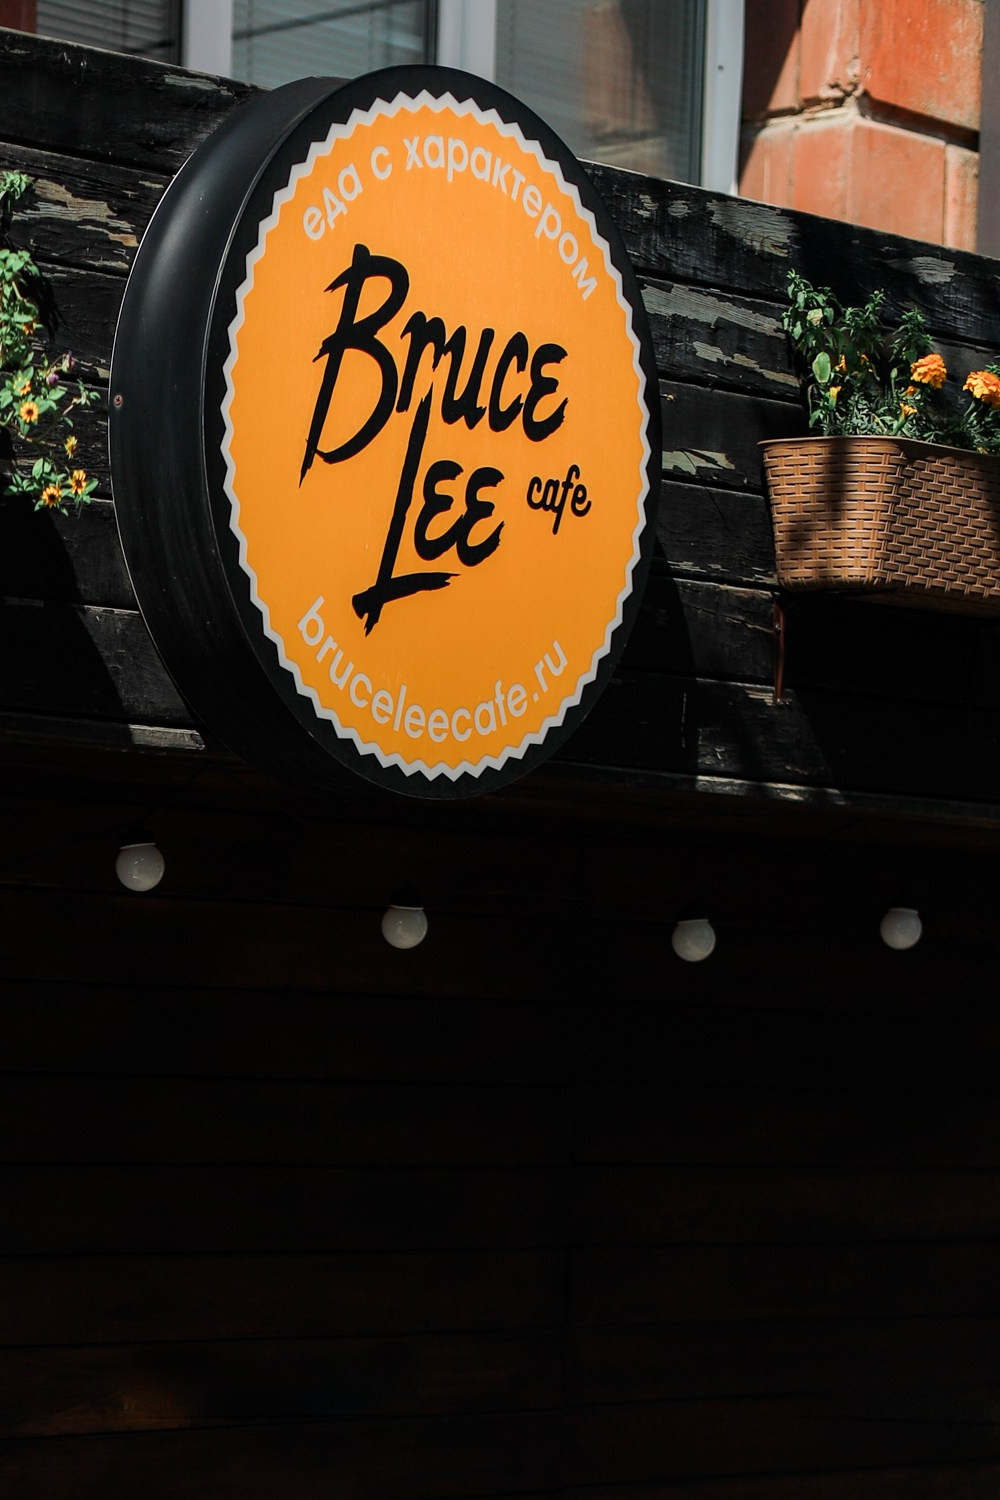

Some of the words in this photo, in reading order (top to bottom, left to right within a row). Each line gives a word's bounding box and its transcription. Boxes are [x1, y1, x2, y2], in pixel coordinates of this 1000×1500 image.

[302, 163, 363, 241] еда
[370, 145, 393, 180] с
[402, 134, 598, 300] характером
[526, 464, 592, 535] cafe
[297, 596, 569, 743] bruceleecafe.ru
